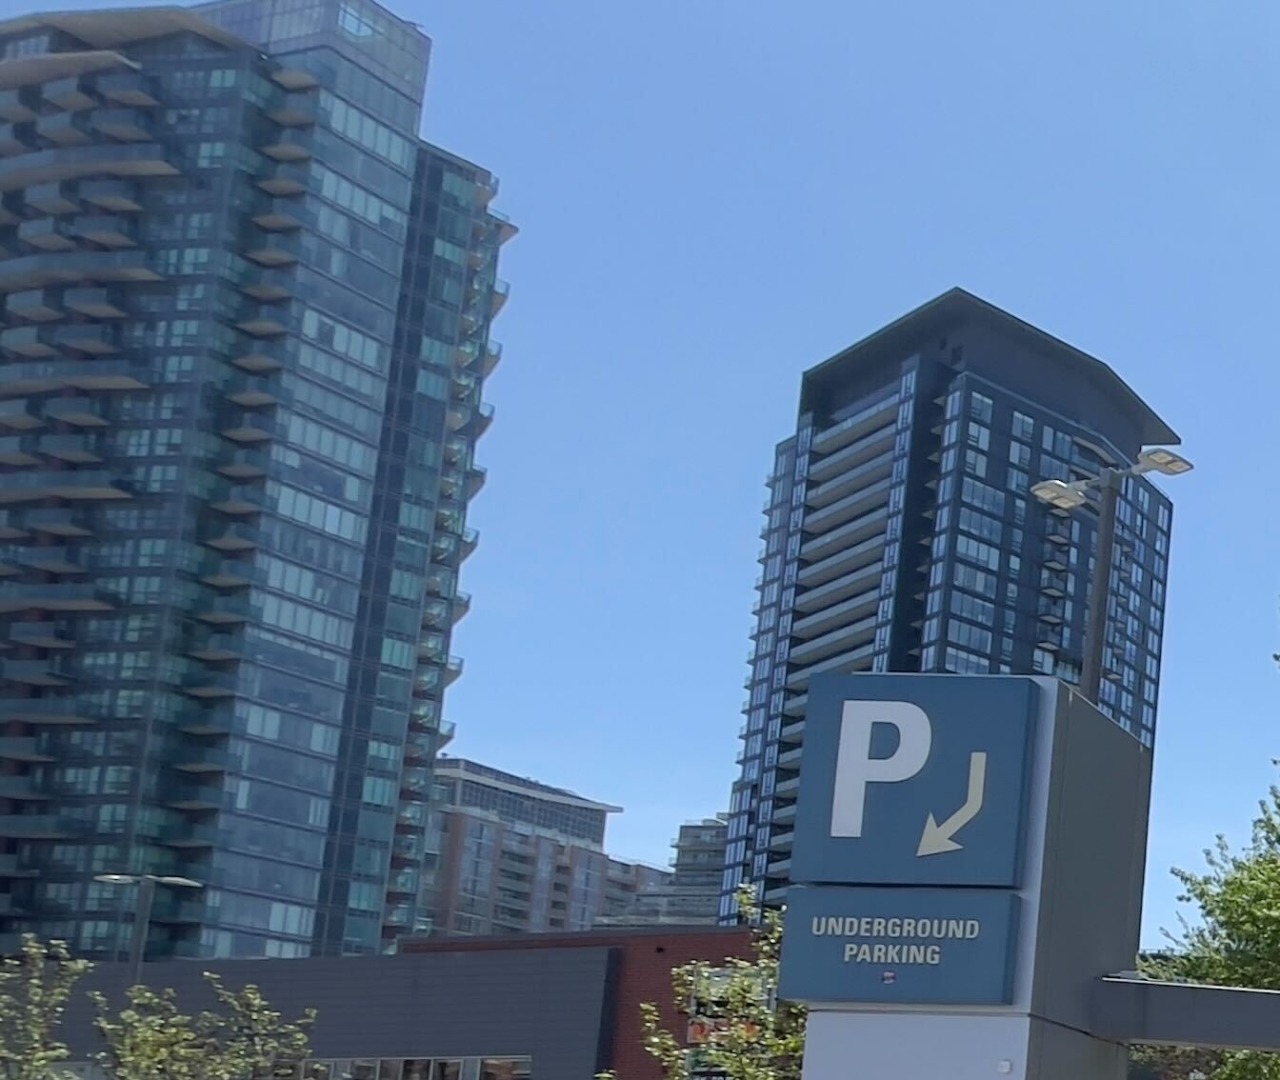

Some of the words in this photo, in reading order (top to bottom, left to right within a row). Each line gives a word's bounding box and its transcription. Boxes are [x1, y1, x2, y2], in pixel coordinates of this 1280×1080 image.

[830, 700, 932, 837] P
[811, 916, 979, 939] UNDERGROUND
[843, 943, 940, 965] PARKING
